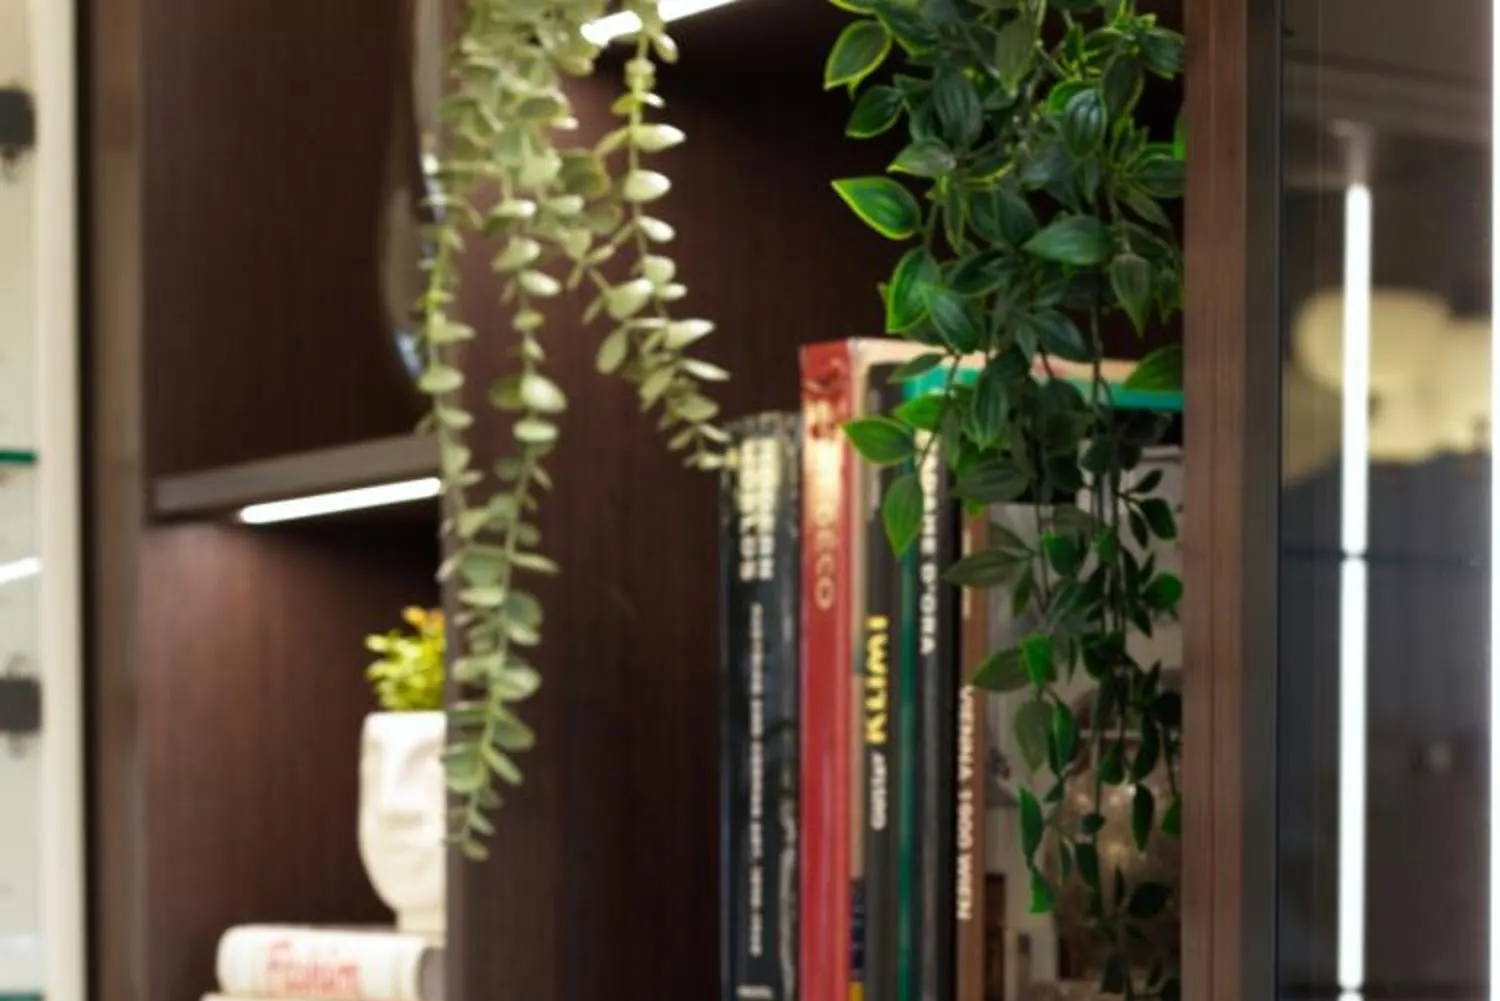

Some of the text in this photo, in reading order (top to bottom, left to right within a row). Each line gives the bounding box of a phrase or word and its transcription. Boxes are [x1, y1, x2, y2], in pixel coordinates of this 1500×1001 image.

[920, 562, 938, 655] D'ORA
[865, 614, 890, 745] KLIMT
[956, 684, 975, 922] VIENNA 1900 WIEN
